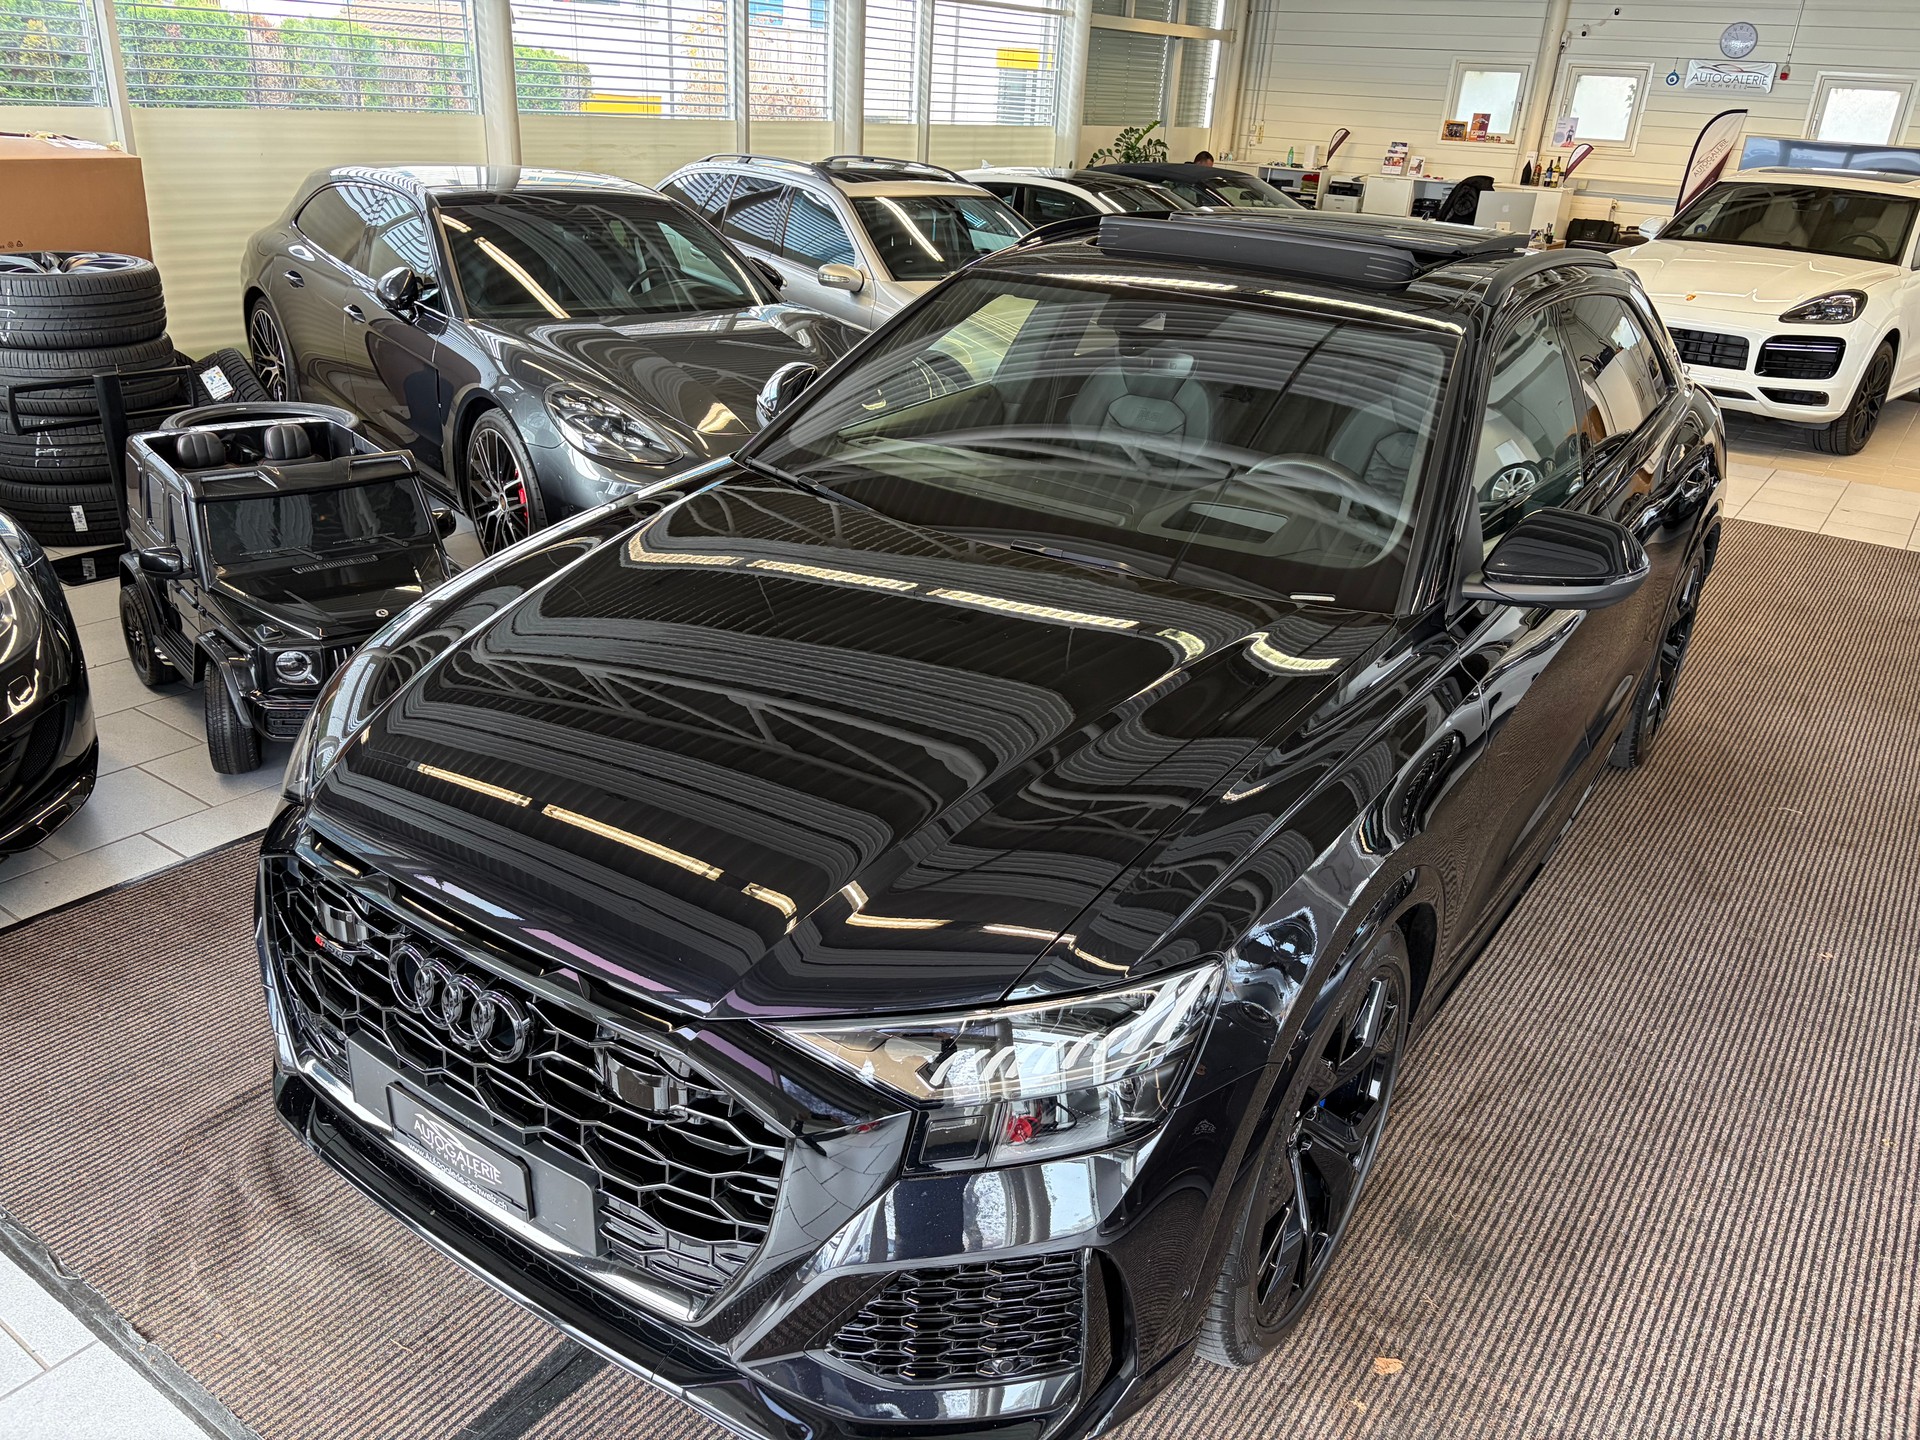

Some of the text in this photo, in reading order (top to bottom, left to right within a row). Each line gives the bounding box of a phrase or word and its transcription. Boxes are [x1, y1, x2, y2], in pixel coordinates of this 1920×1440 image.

[1690, 72, 1769, 86] AUTOGALERIE
[1693, 139, 1729, 178] AUTOGALERIE
[413, 1119, 503, 1185] AUTOGALERIE
